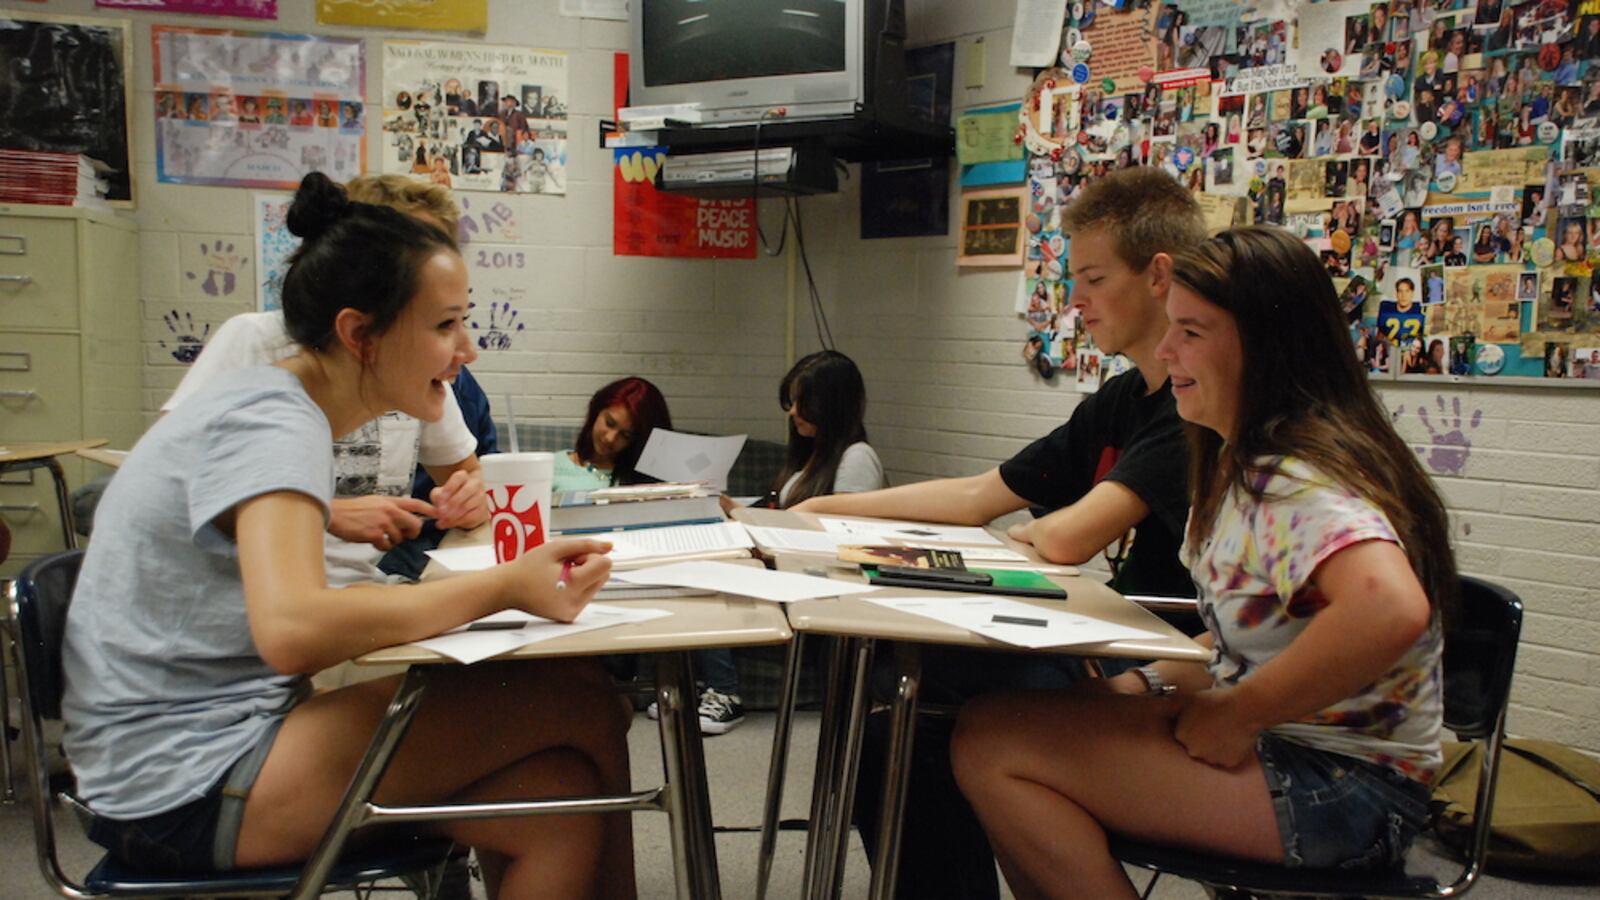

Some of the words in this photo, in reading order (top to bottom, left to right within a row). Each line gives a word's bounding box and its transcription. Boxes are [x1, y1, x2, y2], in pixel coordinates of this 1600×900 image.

[528, 54, 564, 68] MONTH
[1237, 80, 1249, 92] But
[1264, 78, 1277, 87] Not
[1279, 75, 1291, 86] the
[697, 207, 751, 229] PEACE
[698, 228, 749, 248] MUSIC
[476, 250, 525, 269] 2013
